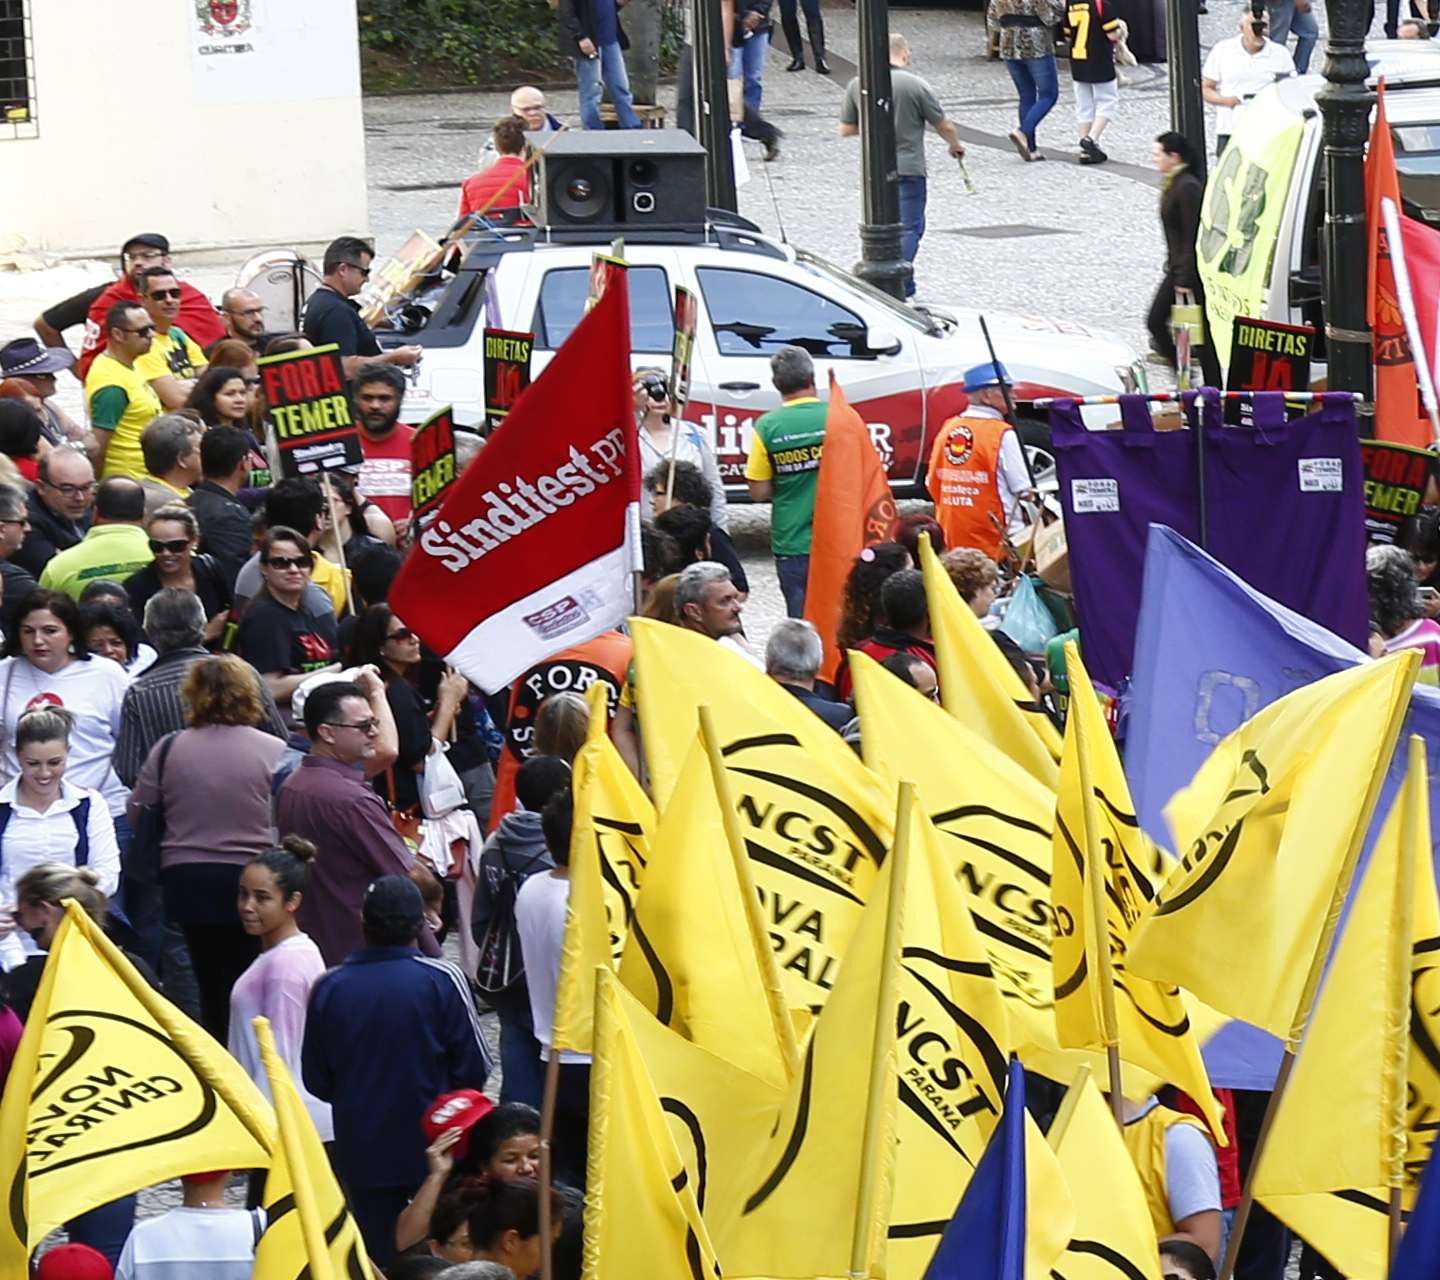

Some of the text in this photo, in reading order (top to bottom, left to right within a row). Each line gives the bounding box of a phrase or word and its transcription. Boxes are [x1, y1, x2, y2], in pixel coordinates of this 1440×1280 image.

[485, 337, 530, 363] DIRETAS
[1237, 322, 1308, 357] DIRETAS
[262, 354, 342, 404] FORA
[270, 394, 352, 440] TEMER
[737, 795, 863, 872] NCST
[896, 1001, 1001, 1120] NCST
